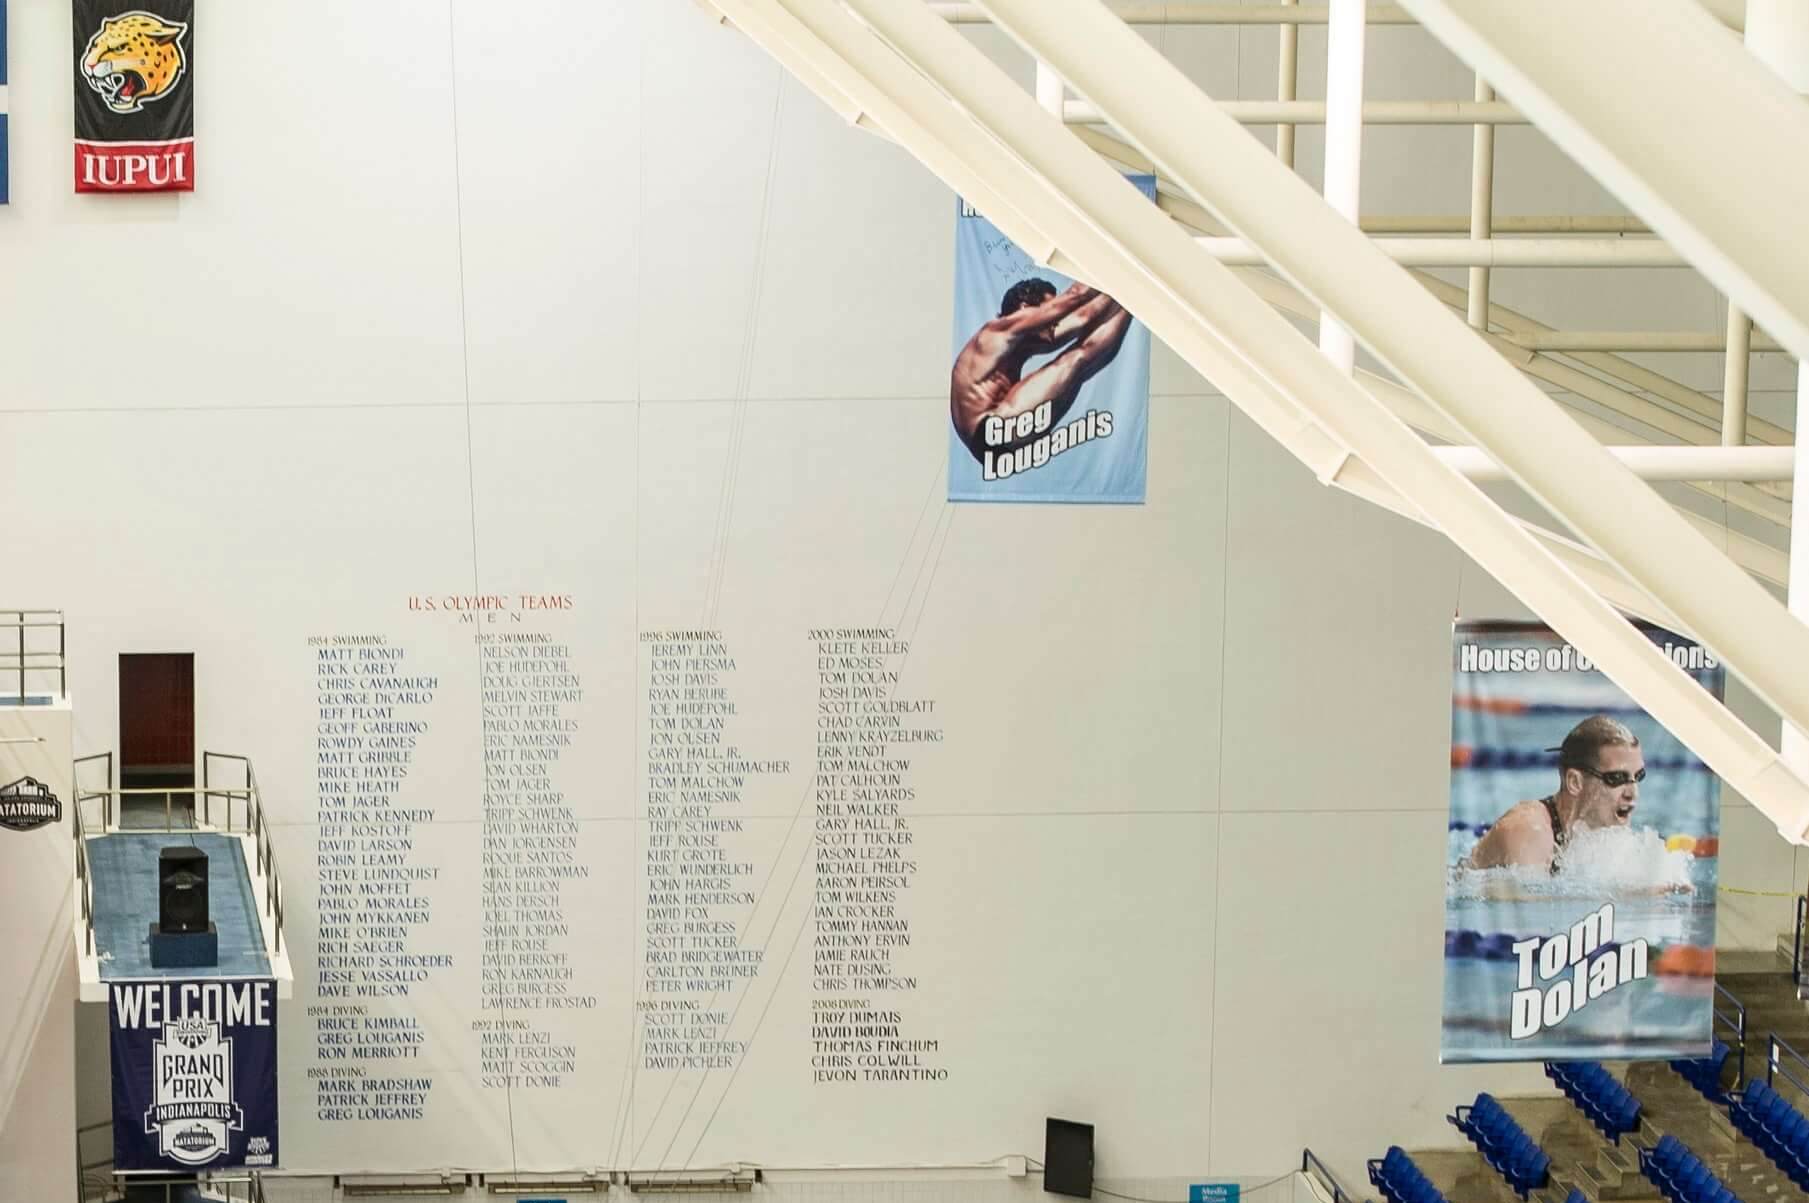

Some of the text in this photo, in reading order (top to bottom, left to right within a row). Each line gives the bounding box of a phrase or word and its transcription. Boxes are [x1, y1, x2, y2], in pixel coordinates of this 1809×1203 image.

[82, 151, 187, 186] IUPUI
[984, 399, 1052, 446] Greg
[983, 409, 1113, 481] Louganis
[444, 594, 509, 611] OLYMPIC
[520, 594, 573, 611] TEAMS
[1461, 644, 1541, 673] House
[1545, 643, 1576, 672] of
[318, 663, 397, 676] RICK CAREY
[650, 718, 725, 730] TOM DOLAN
[318, 736, 417, 748] ROWDY GAINES
[318, 766, 407, 778] BRUCE HAYES
[318, 781, 399, 793] MIKE HEATH
[815, 862, 917, 874] MICHAEL PHELPS
[816, 920, 909, 932] TOMMY HANNAN
[1512, 902, 1615, 990] Tom
[318, 956, 453, 968] RICHARD SCHROEDER
[318, 985, 408, 997] DAVE WILSON
[1510, 936, 1648, 1039] Dolan
[113, 982, 271, 1029] WELCOME
[180, 1019, 205, 1030] USA
[318, 1018, 420, 1030] BRUCE KIMBALL
[812, 1026, 899, 1039] DAVID BOUDIA
[318, 1047, 420, 1059] RON MERRIOTT
[813, 1040, 938, 1053] THOMAS FINCHUM
[811, 1055, 852, 1067] CHRIS
[163, 1054, 224, 1088] GRAND
[813, 1069, 948, 1084] JEVON TARANTINO
[173, 1078, 214, 1098] PRIX
[318, 1079, 432, 1092] MARK BRADSHAW
[156, 1103, 231, 1121] INDIANAPOLIS
[1201, 1187, 1227, 1195] Media
